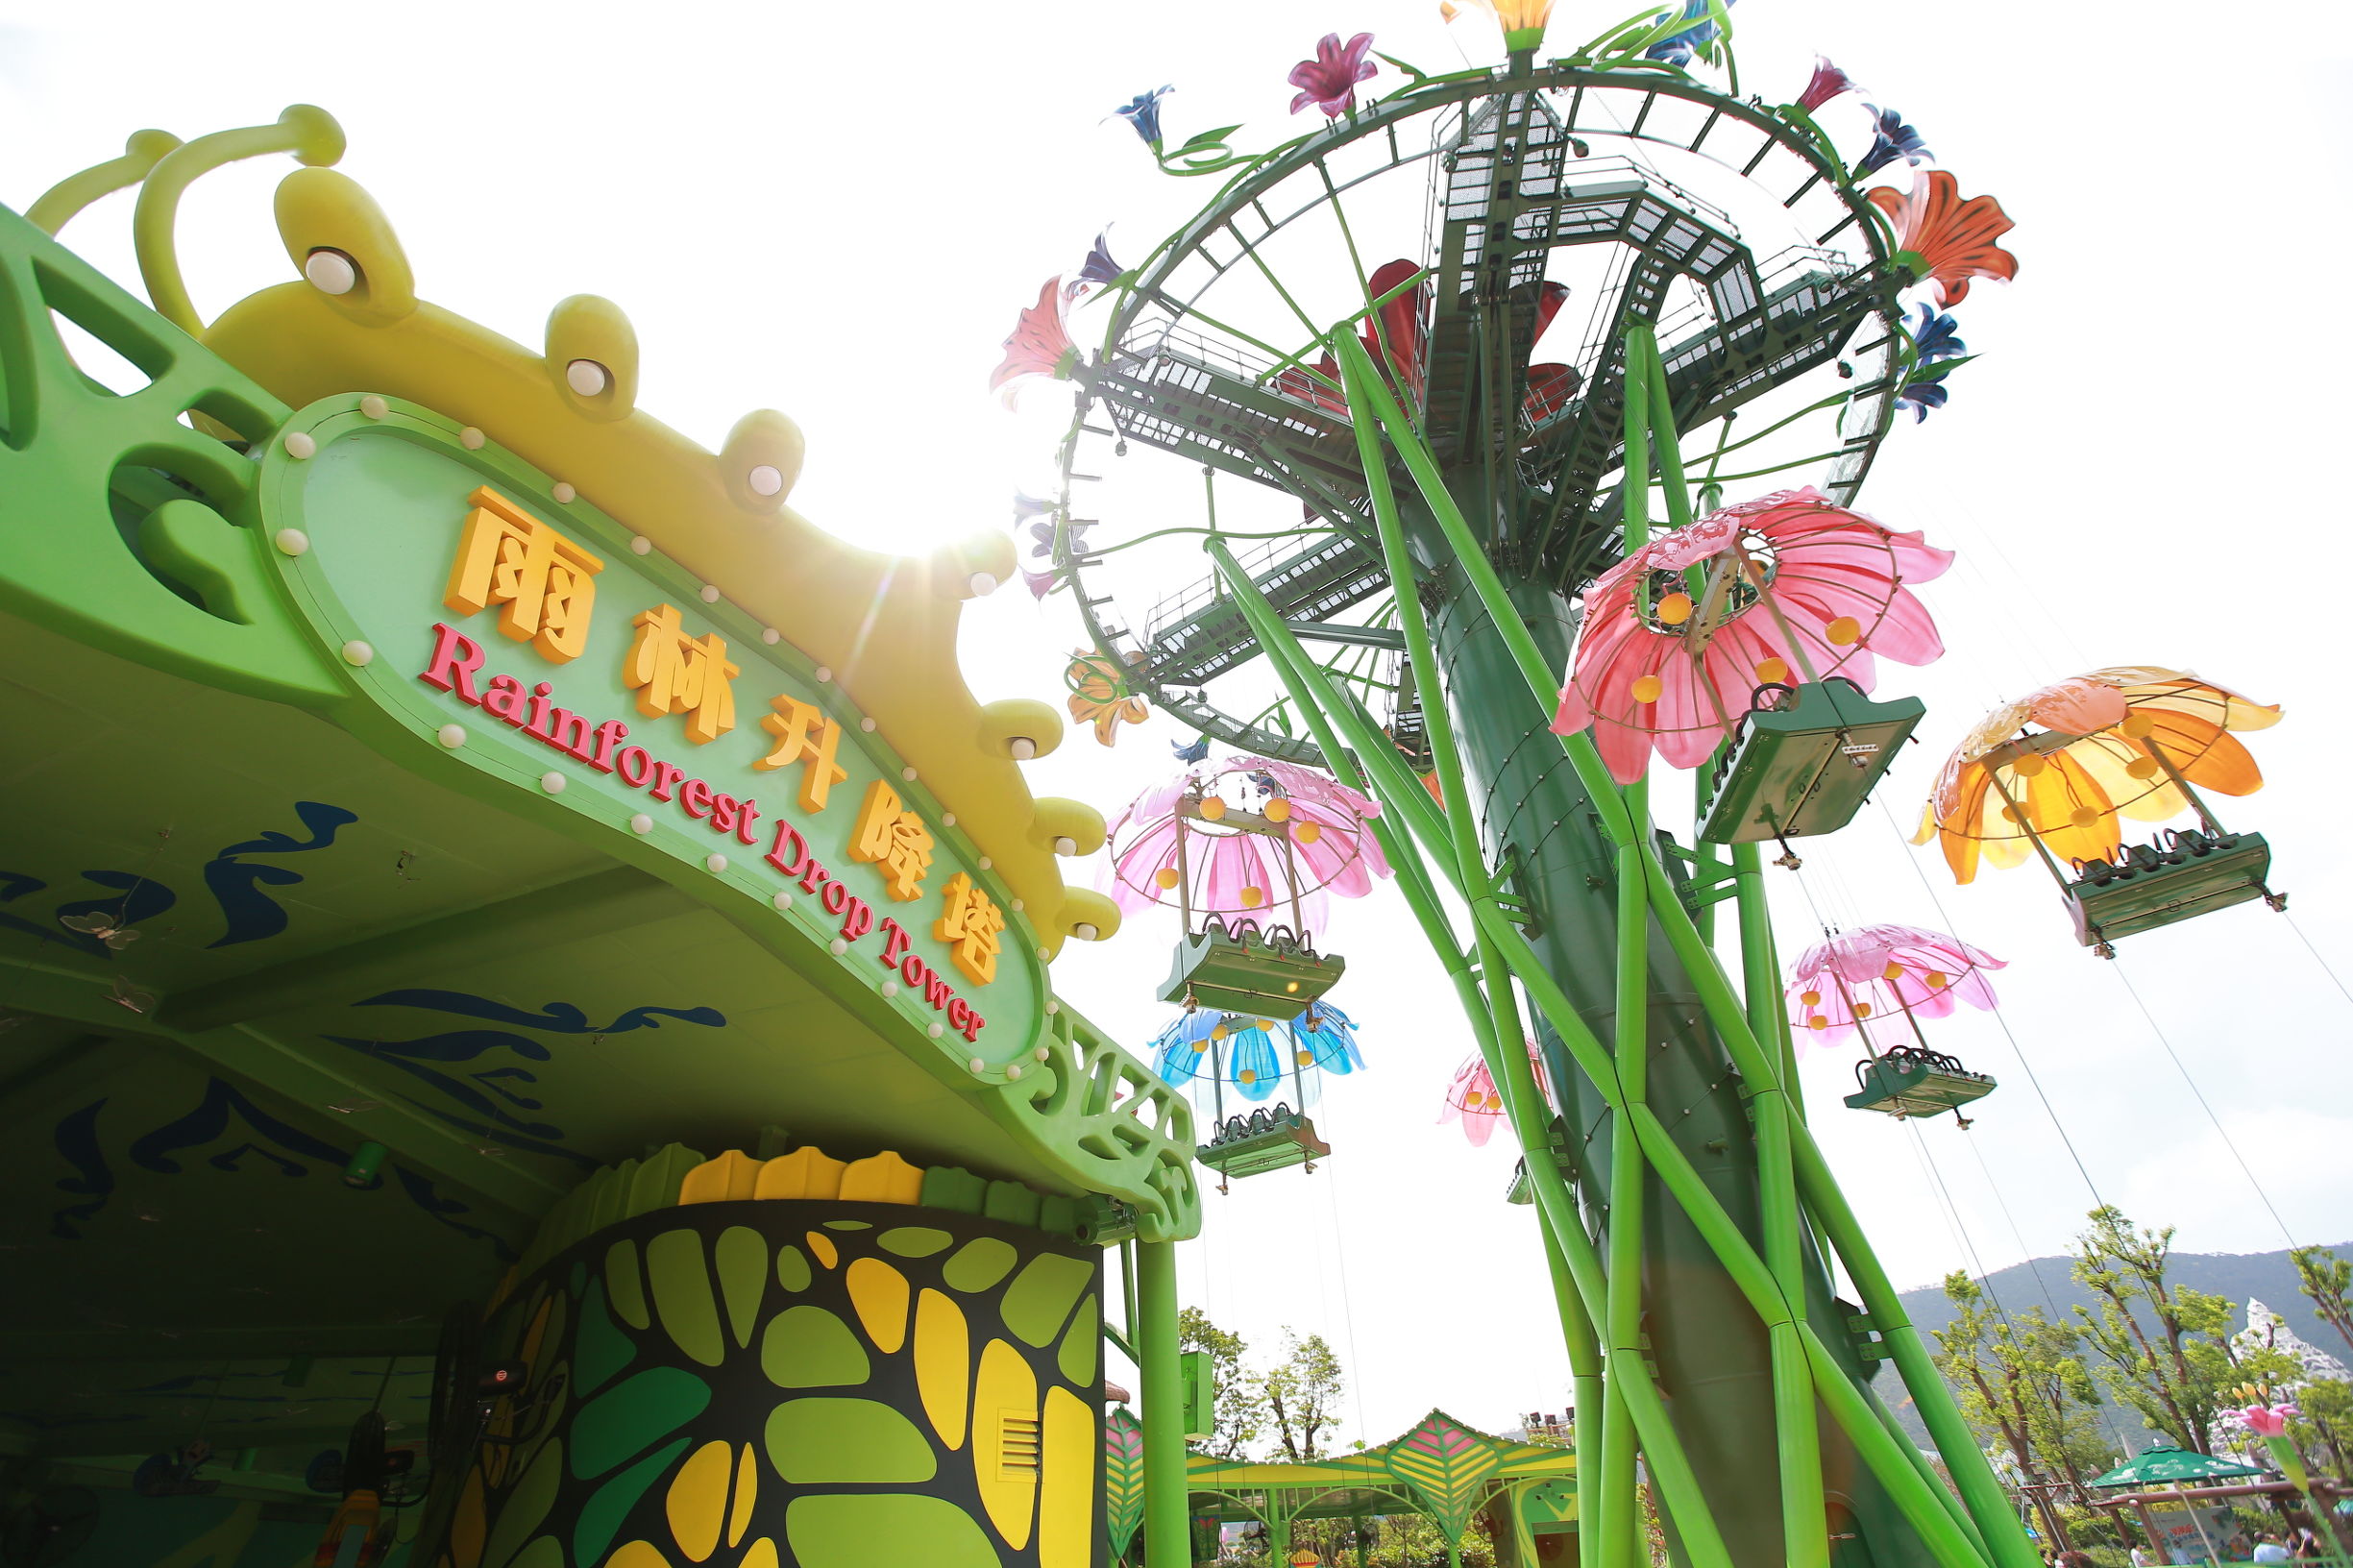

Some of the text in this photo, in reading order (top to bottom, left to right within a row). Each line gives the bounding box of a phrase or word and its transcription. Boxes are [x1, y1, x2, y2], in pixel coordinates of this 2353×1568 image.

[418, 623, 986, 1042] Rainforest Drop Tower
[442, 484, 1006, 987] 雨林升降塔
